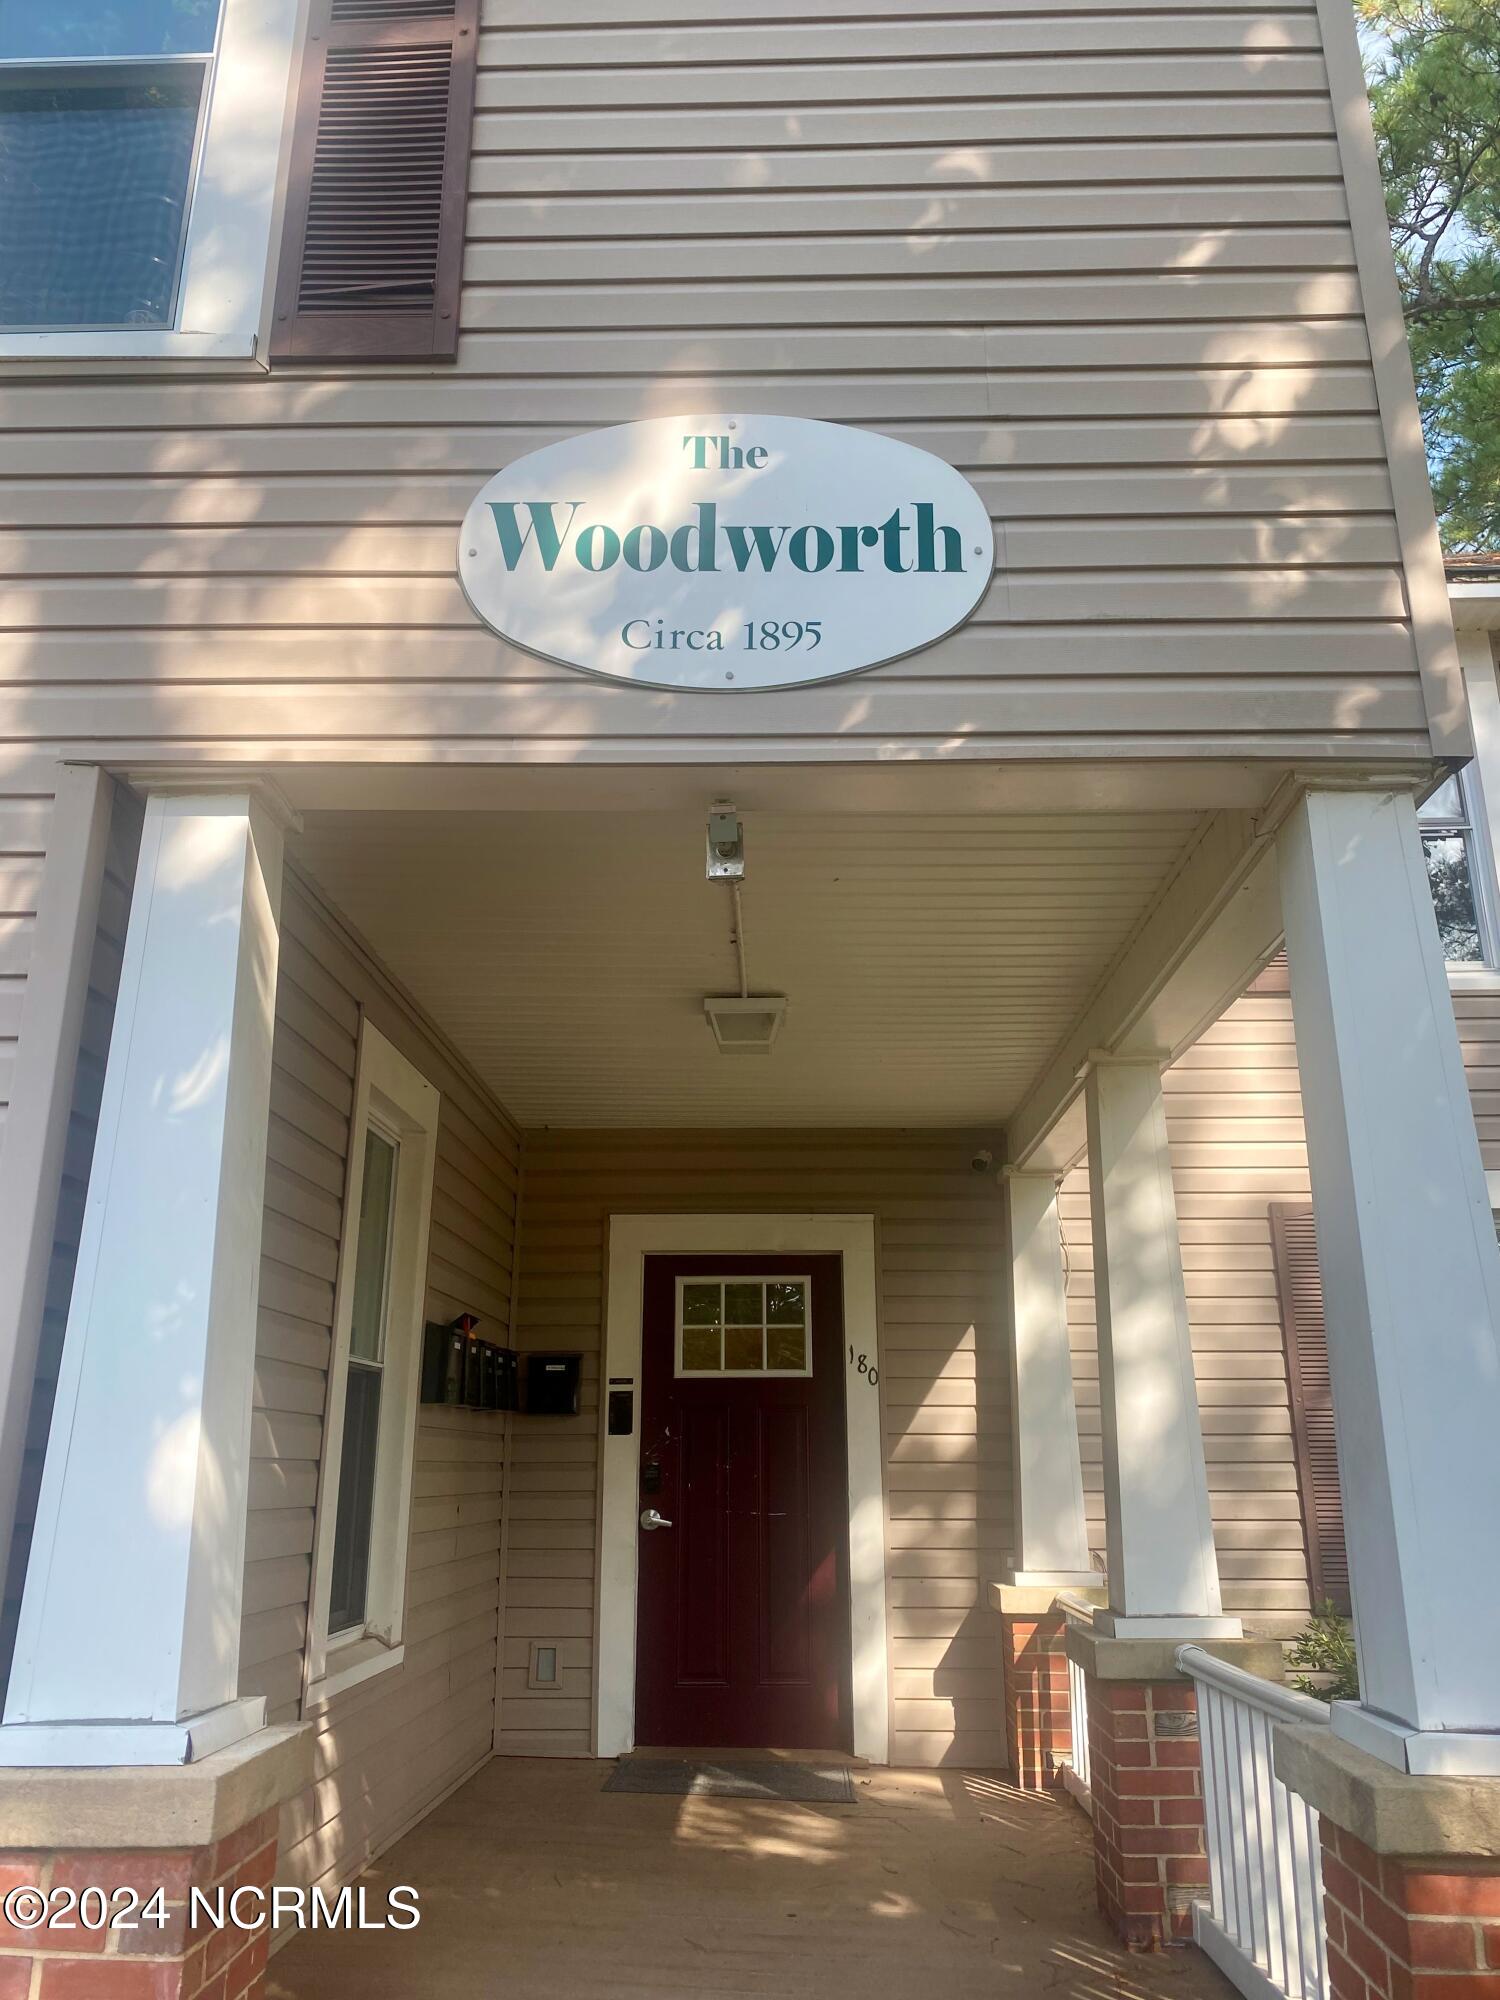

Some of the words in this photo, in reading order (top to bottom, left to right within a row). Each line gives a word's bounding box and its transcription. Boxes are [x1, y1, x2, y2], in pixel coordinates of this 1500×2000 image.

[683, 435, 769, 470] The
[485, 501, 968, 574] Woodworth
[621, 618, 724, 651] Circa
[743, 620, 823, 652] 1895
[849, 1344, 878, 1386] 180
